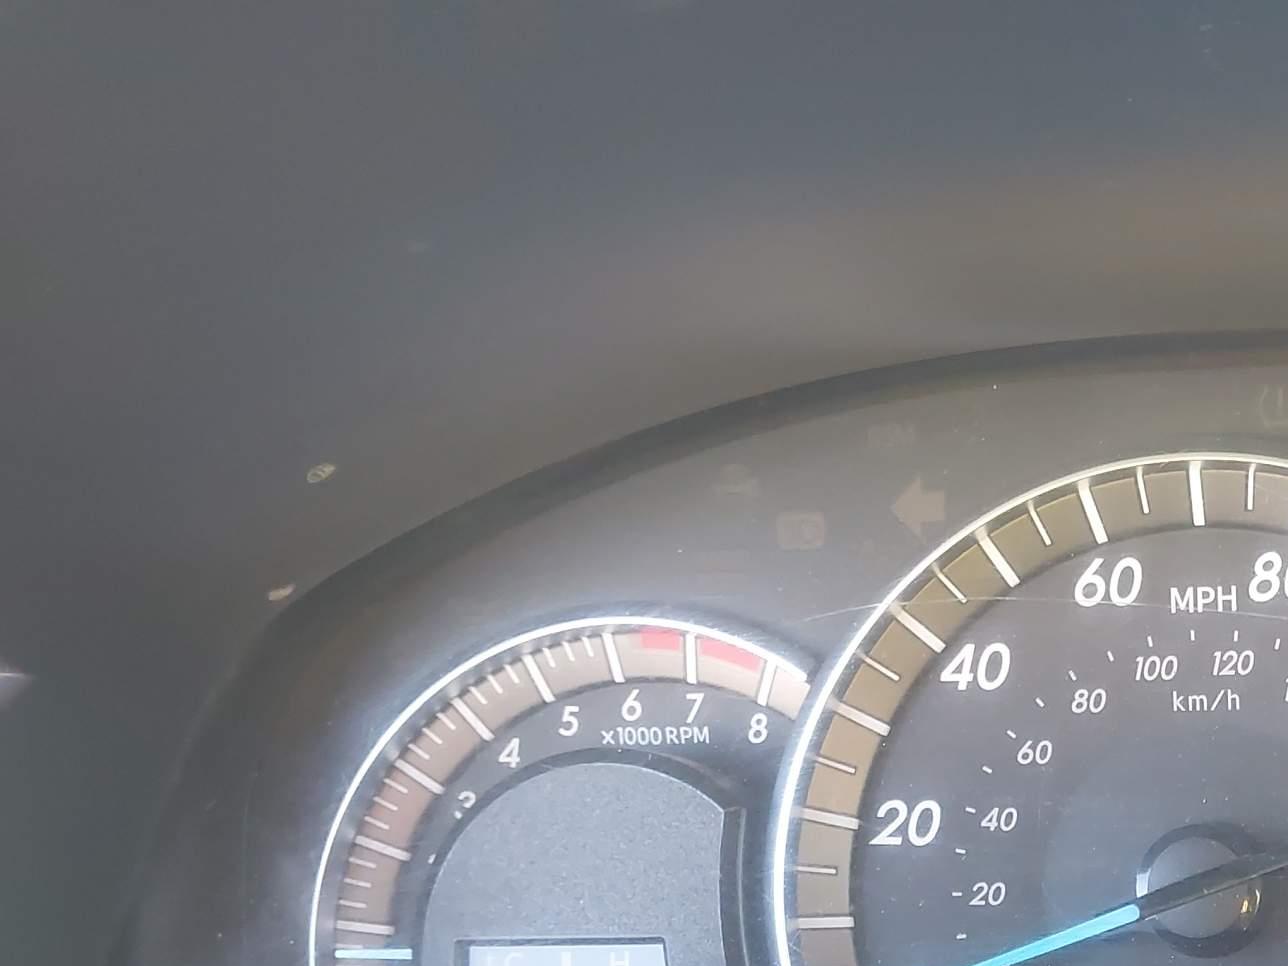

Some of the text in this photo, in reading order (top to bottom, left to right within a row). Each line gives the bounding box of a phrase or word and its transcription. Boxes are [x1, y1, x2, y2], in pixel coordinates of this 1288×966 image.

[1073, 557, 1143, 607] 60
[1169, 585, 1238, 614] MPH
[940, 642, 1011, 691] 40
[1135, 656, 1178, 681] 100
[1212, 650, 1255, 676] 120
[621, 689, 643, 721] 6
[685, 693, 705, 723] 7
[1071, 688, 1107, 714] 80
[1172, 689, 1240, 712] km/h
[558, 706, 580, 736] 5
[748, 713, 769, 743] 8
[601, 727, 710, 746] x1000 RPM
[498, 738, 520, 768] 4
[1016, 740, 1053, 765] 60
[868, 799, 942, 847] 20
[980, 807, 1018, 832] 40
[969, 882, 1006, 906] 20
